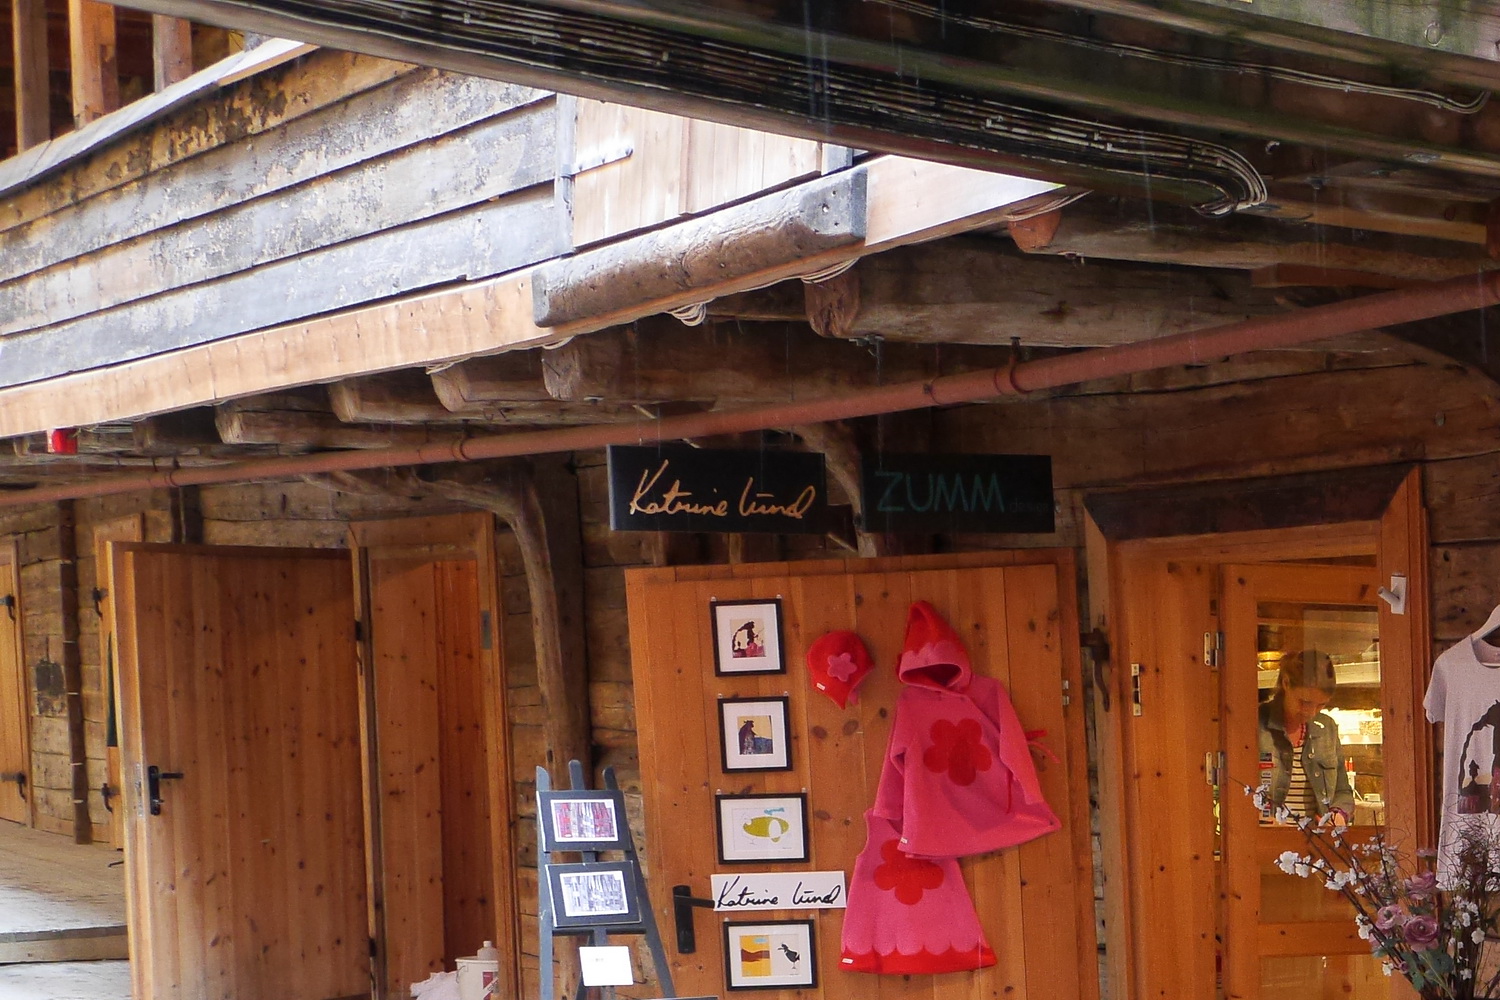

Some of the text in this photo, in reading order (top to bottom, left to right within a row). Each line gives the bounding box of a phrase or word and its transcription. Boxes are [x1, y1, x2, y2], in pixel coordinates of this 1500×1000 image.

[629, 459, 729, 516] Katrine
[874, 470, 1006, 512] ZUMM
[716, 875, 779, 909] Katrine
